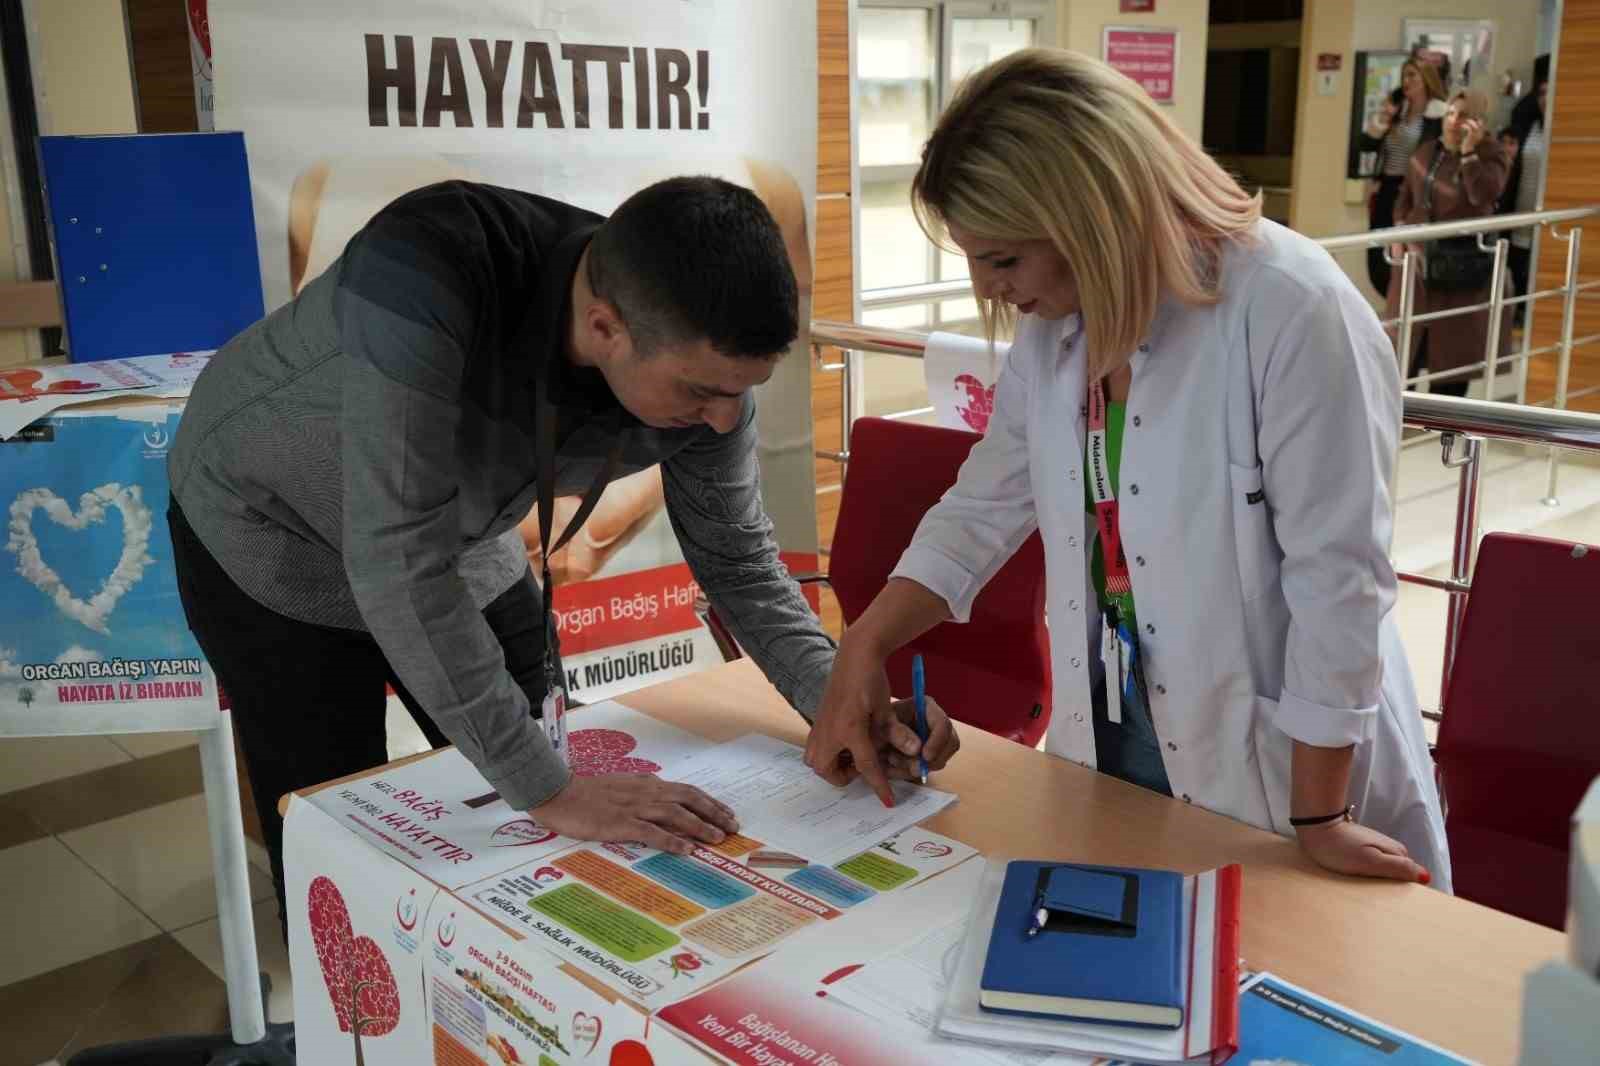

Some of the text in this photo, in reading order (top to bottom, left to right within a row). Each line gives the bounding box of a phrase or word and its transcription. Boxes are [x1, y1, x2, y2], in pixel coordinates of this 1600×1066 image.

[364, 33, 711, 131] HAYATTIR!
[610, 591, 659, 619] Bağış
[22, 658, 201, 681] ORGAN BAĞIŞI YAPIN
[584, 638, 695, 688] MÜDÜRLÜĞÜ
[57, 681, 204, 704] HAYATA İZ BIRAKIN
[392, 789, 452, 822] BAĞIŞ
[377, 811, 474, 865] HAYATTIR
[531, 920, 578, 947] SAĞLIK
[697, 1013, 735, 1038] Yeni
[724, 1030, 753, 1049] Bir
[737, 1012, 817, 1061] Bağışlanan
